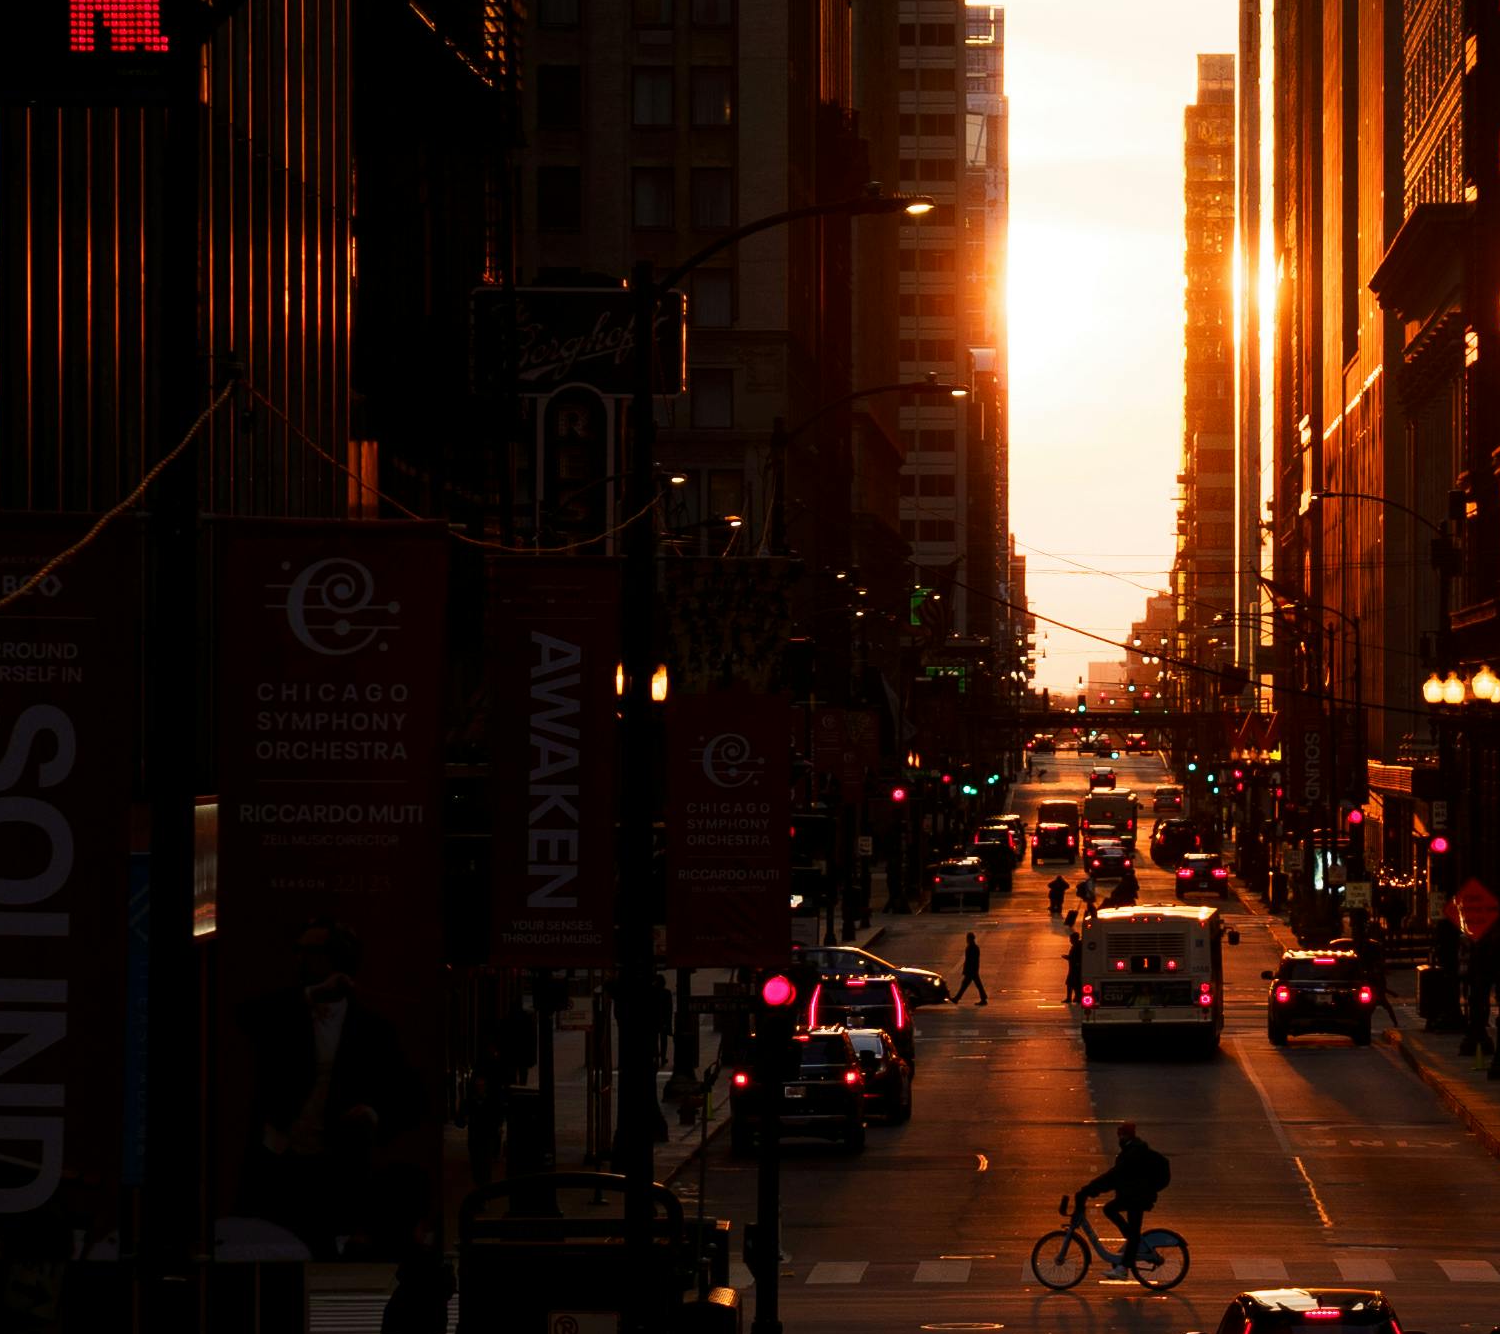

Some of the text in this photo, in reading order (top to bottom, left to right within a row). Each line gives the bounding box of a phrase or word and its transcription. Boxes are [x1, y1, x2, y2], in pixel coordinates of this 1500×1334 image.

[61, 667, 83, 684] IN
[256, 683, 409, 703] CHICAGO
[256, 711, 408, 732] SYMPHONY
[256, 741, 409, 761] ORCHESTRA
[526, 630, 582, 908] AWAKEN
[239, 804, 424, 824] RICCARDO MUTI
[685, 802, 771, 815] CHICAGO
[685, 818, 771, 830] SYMPHONY
[336, 834, 400, 847] DIRECTOR
[685, 834, 772, 847] ORCHESTRA
[677, 868, 780, 881] RICCARDO MUTI
[511, 919, 544, 931] YOUR
[501, 933, 603, 945] THROUGH MUSIC
